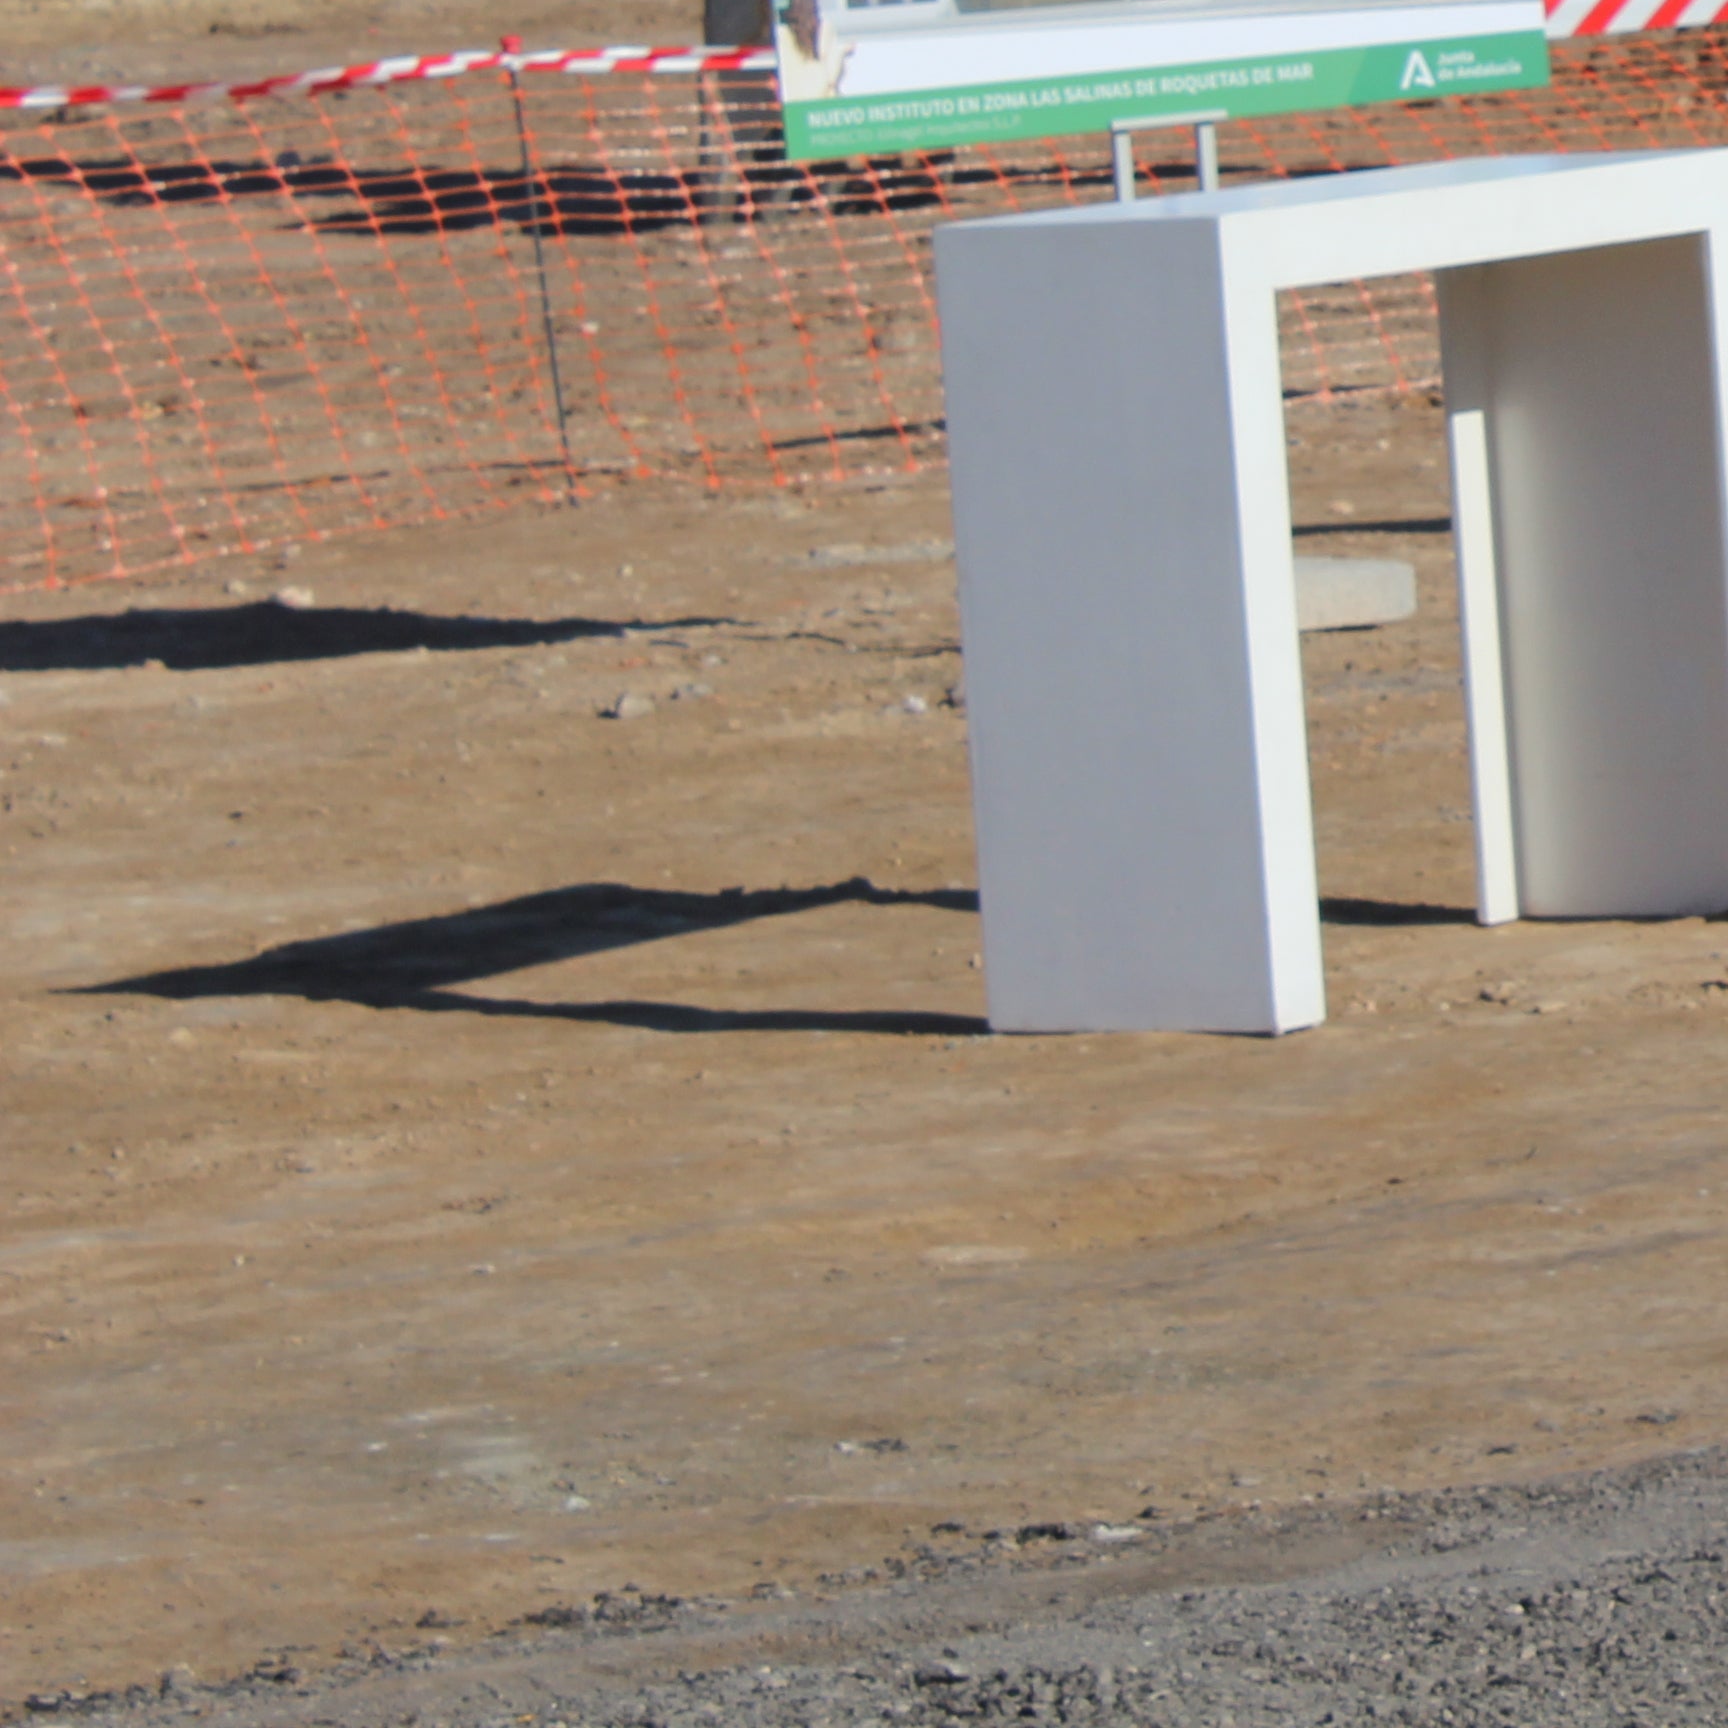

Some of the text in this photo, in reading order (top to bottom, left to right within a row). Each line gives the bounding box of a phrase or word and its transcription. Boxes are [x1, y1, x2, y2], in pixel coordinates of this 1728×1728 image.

[807, 61, 1314, 129] NUEVO INSTITUTO EN ZONA LAS SALINAS DE ROQUETAS DE MAR
